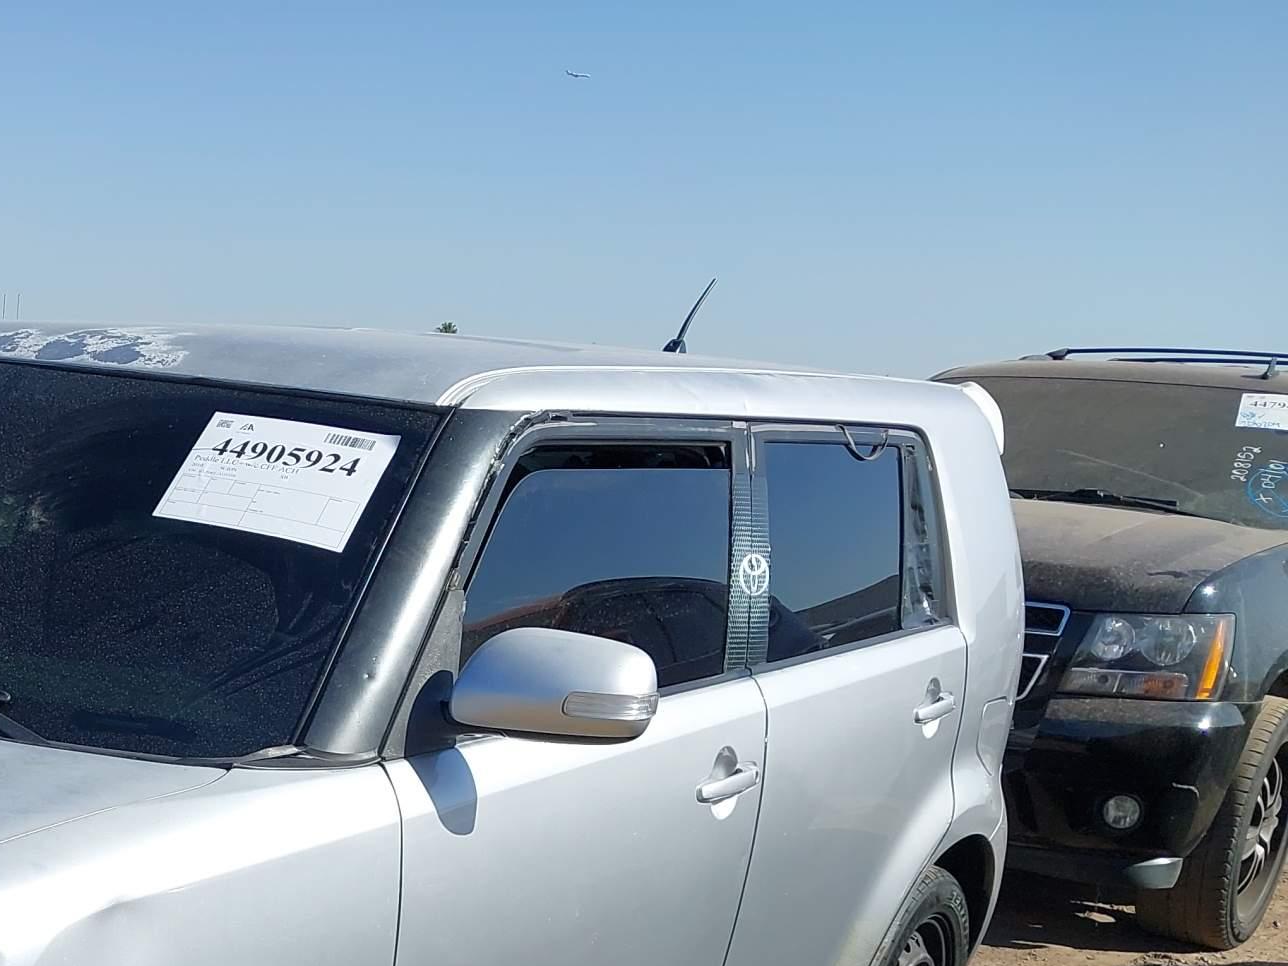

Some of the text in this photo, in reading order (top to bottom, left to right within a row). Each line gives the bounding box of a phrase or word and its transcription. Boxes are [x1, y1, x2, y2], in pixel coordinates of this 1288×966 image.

[1249, 401, 1288, 409] 4479
[212, 437, 361, 477] 44905924
[1230, 446, 1263, 482] 208152
